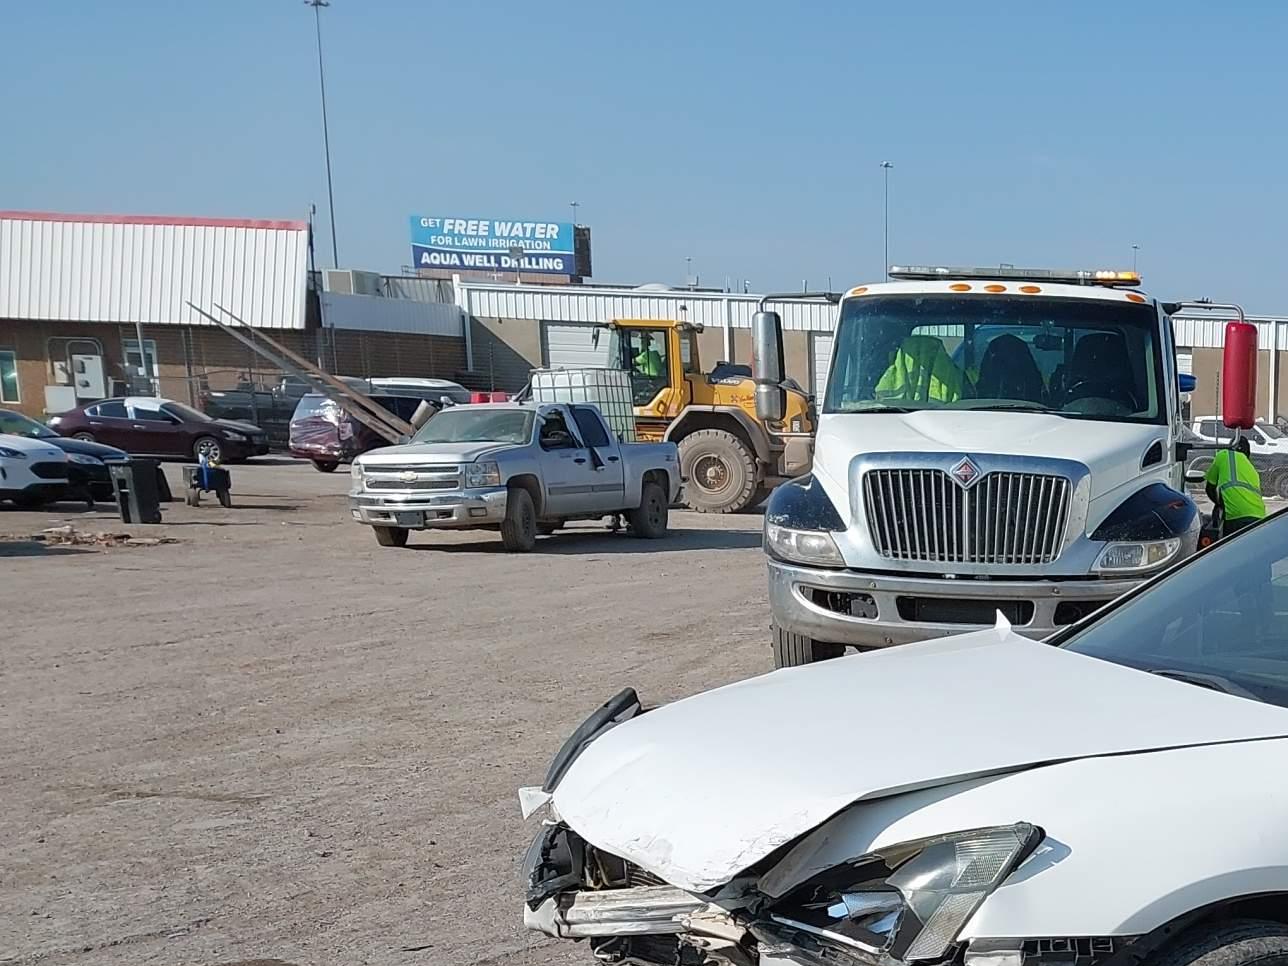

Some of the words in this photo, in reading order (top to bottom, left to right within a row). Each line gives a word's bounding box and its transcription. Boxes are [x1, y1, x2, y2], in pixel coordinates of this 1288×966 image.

[420, 217, 441, 228] GET
[443, 218, 490, 236] FREE
[494, 221, 560, 239] WATER
[430, 235, 452, 246] FOR
[454, 236, 486, 247] LAWN
[488, 238, 551, 250] IRRIGATION
[420, 252, 461, 266] AQUA
[462, 254, 498, 268] WELL
